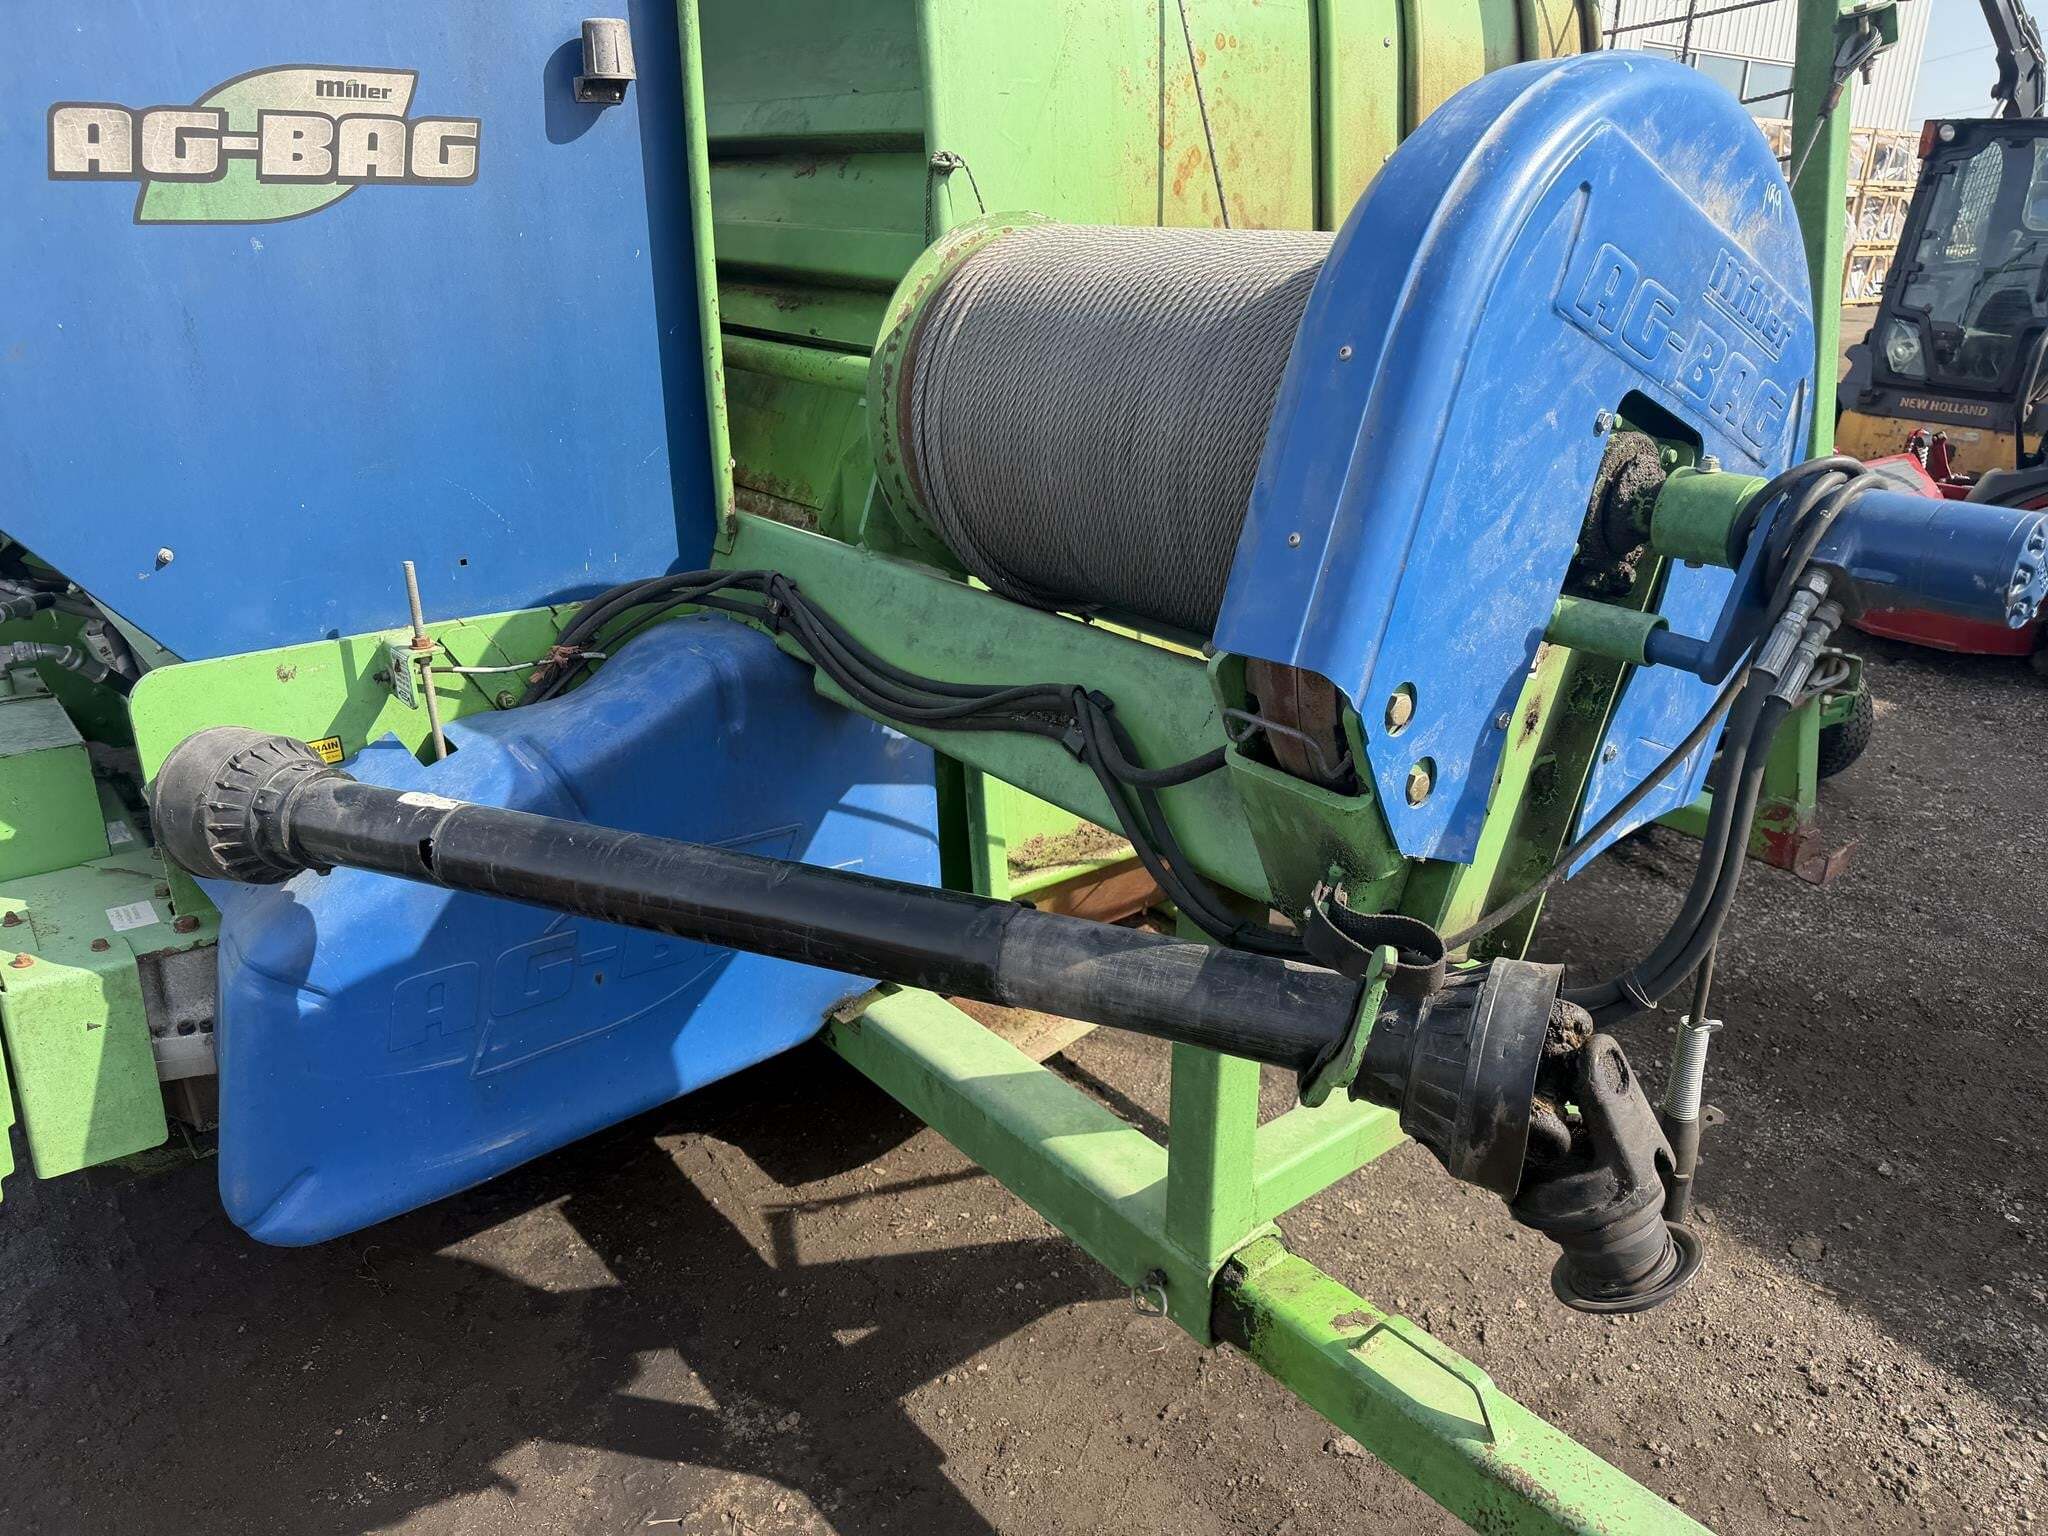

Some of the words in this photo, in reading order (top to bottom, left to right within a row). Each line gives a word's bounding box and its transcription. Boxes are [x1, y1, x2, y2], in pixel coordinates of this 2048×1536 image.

[50, 104, 480, 184] AG-BAG
[1575, 243, 1788, 448] AG-BAG
[1900, 397, 1929, 410] NEW
[1929, 400, 1989, 416] HOLLAND
